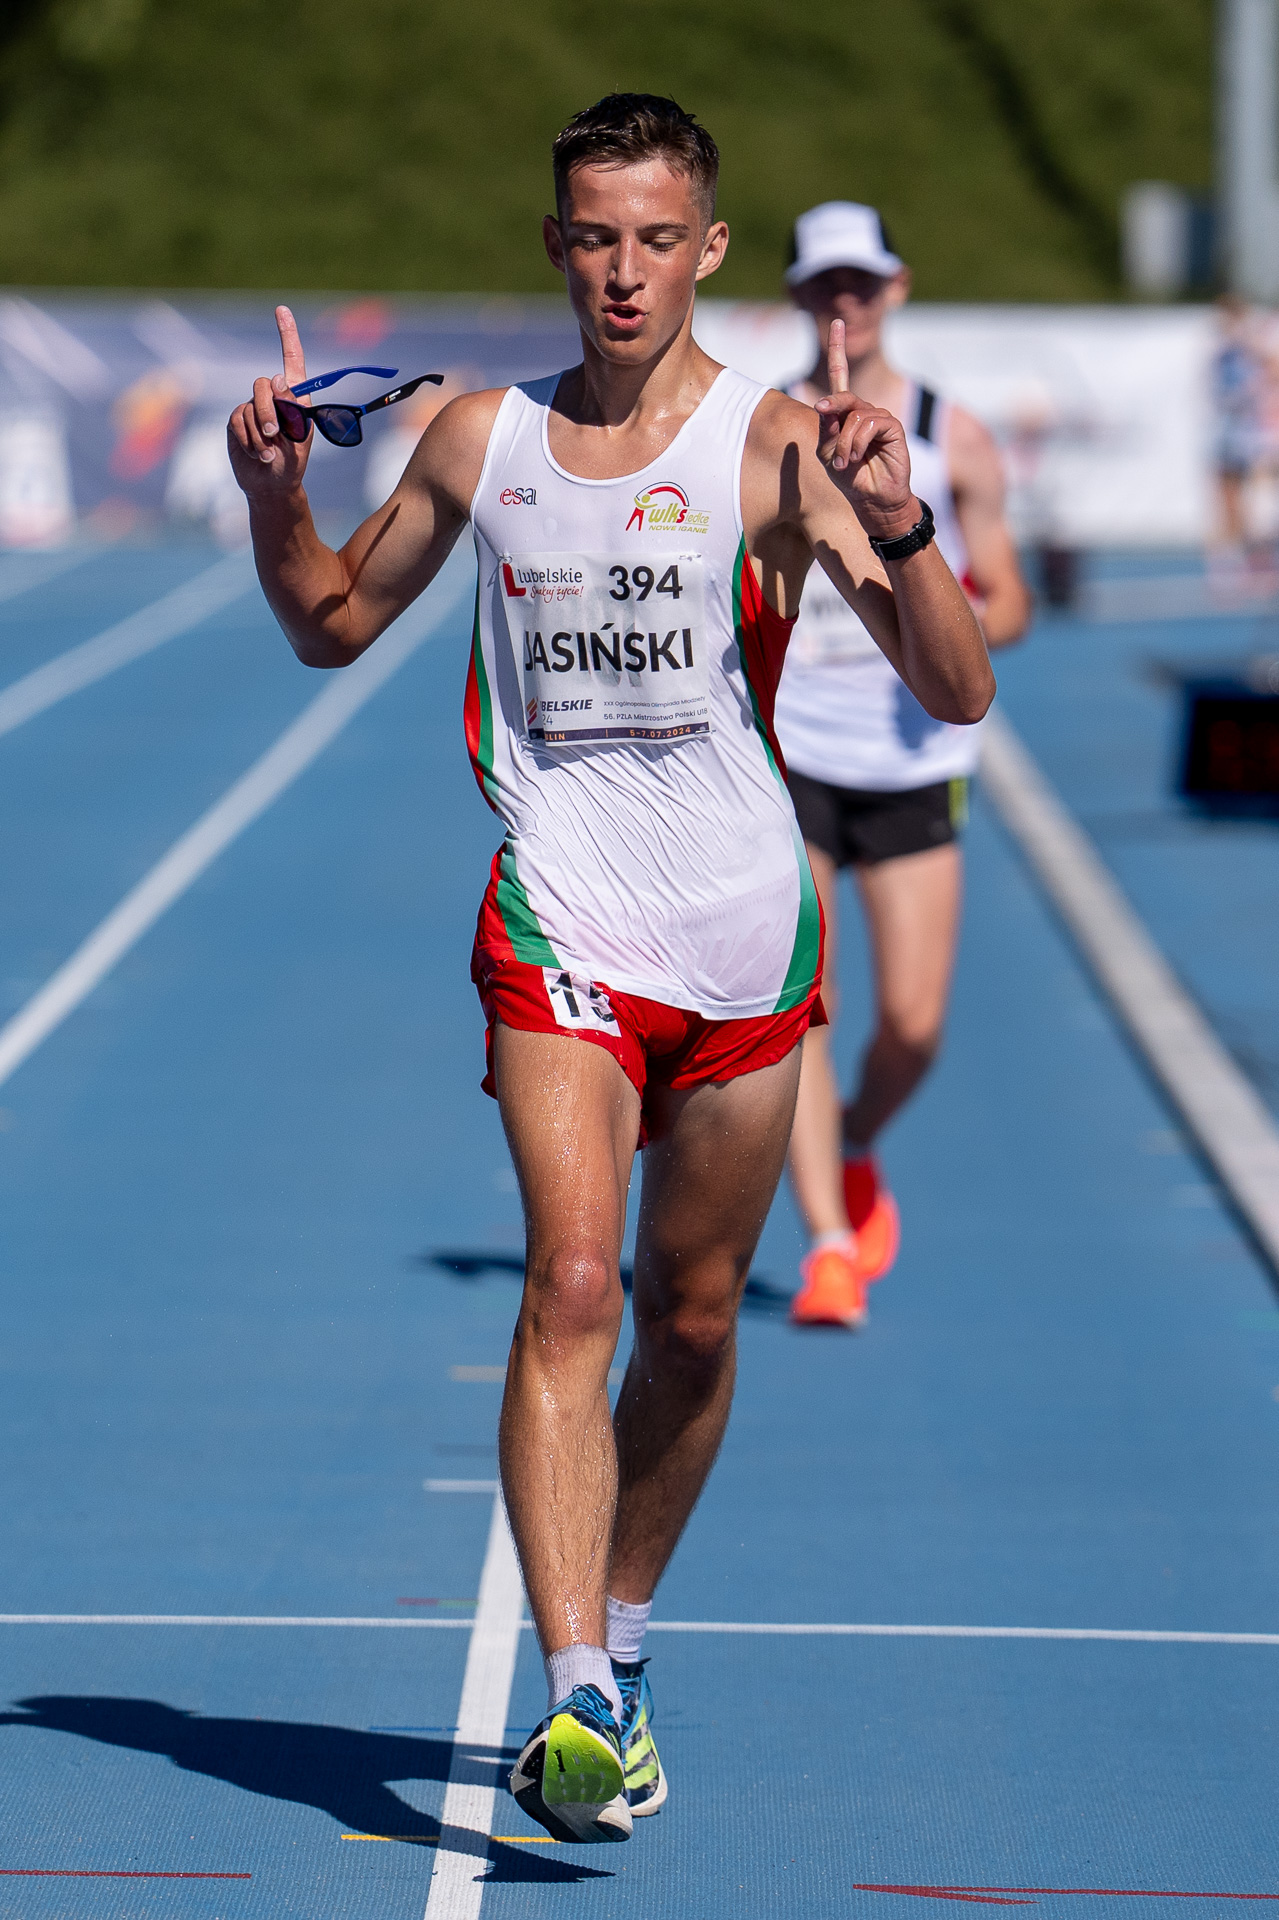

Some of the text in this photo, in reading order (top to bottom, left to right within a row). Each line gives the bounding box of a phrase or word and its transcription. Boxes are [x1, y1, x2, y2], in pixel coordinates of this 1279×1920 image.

[678, 526, 708, 534] IGANIE
[608, 564, 683, 601] 394
[525, 623, 694, 672] JASIŃSKI
[541, 699, 593, 712] BELSKIE
[674, 710, 696, 719] Polski
[696, 707, 708, 716] U18
[629, 726, 691, 738] 5-7.07.2024
